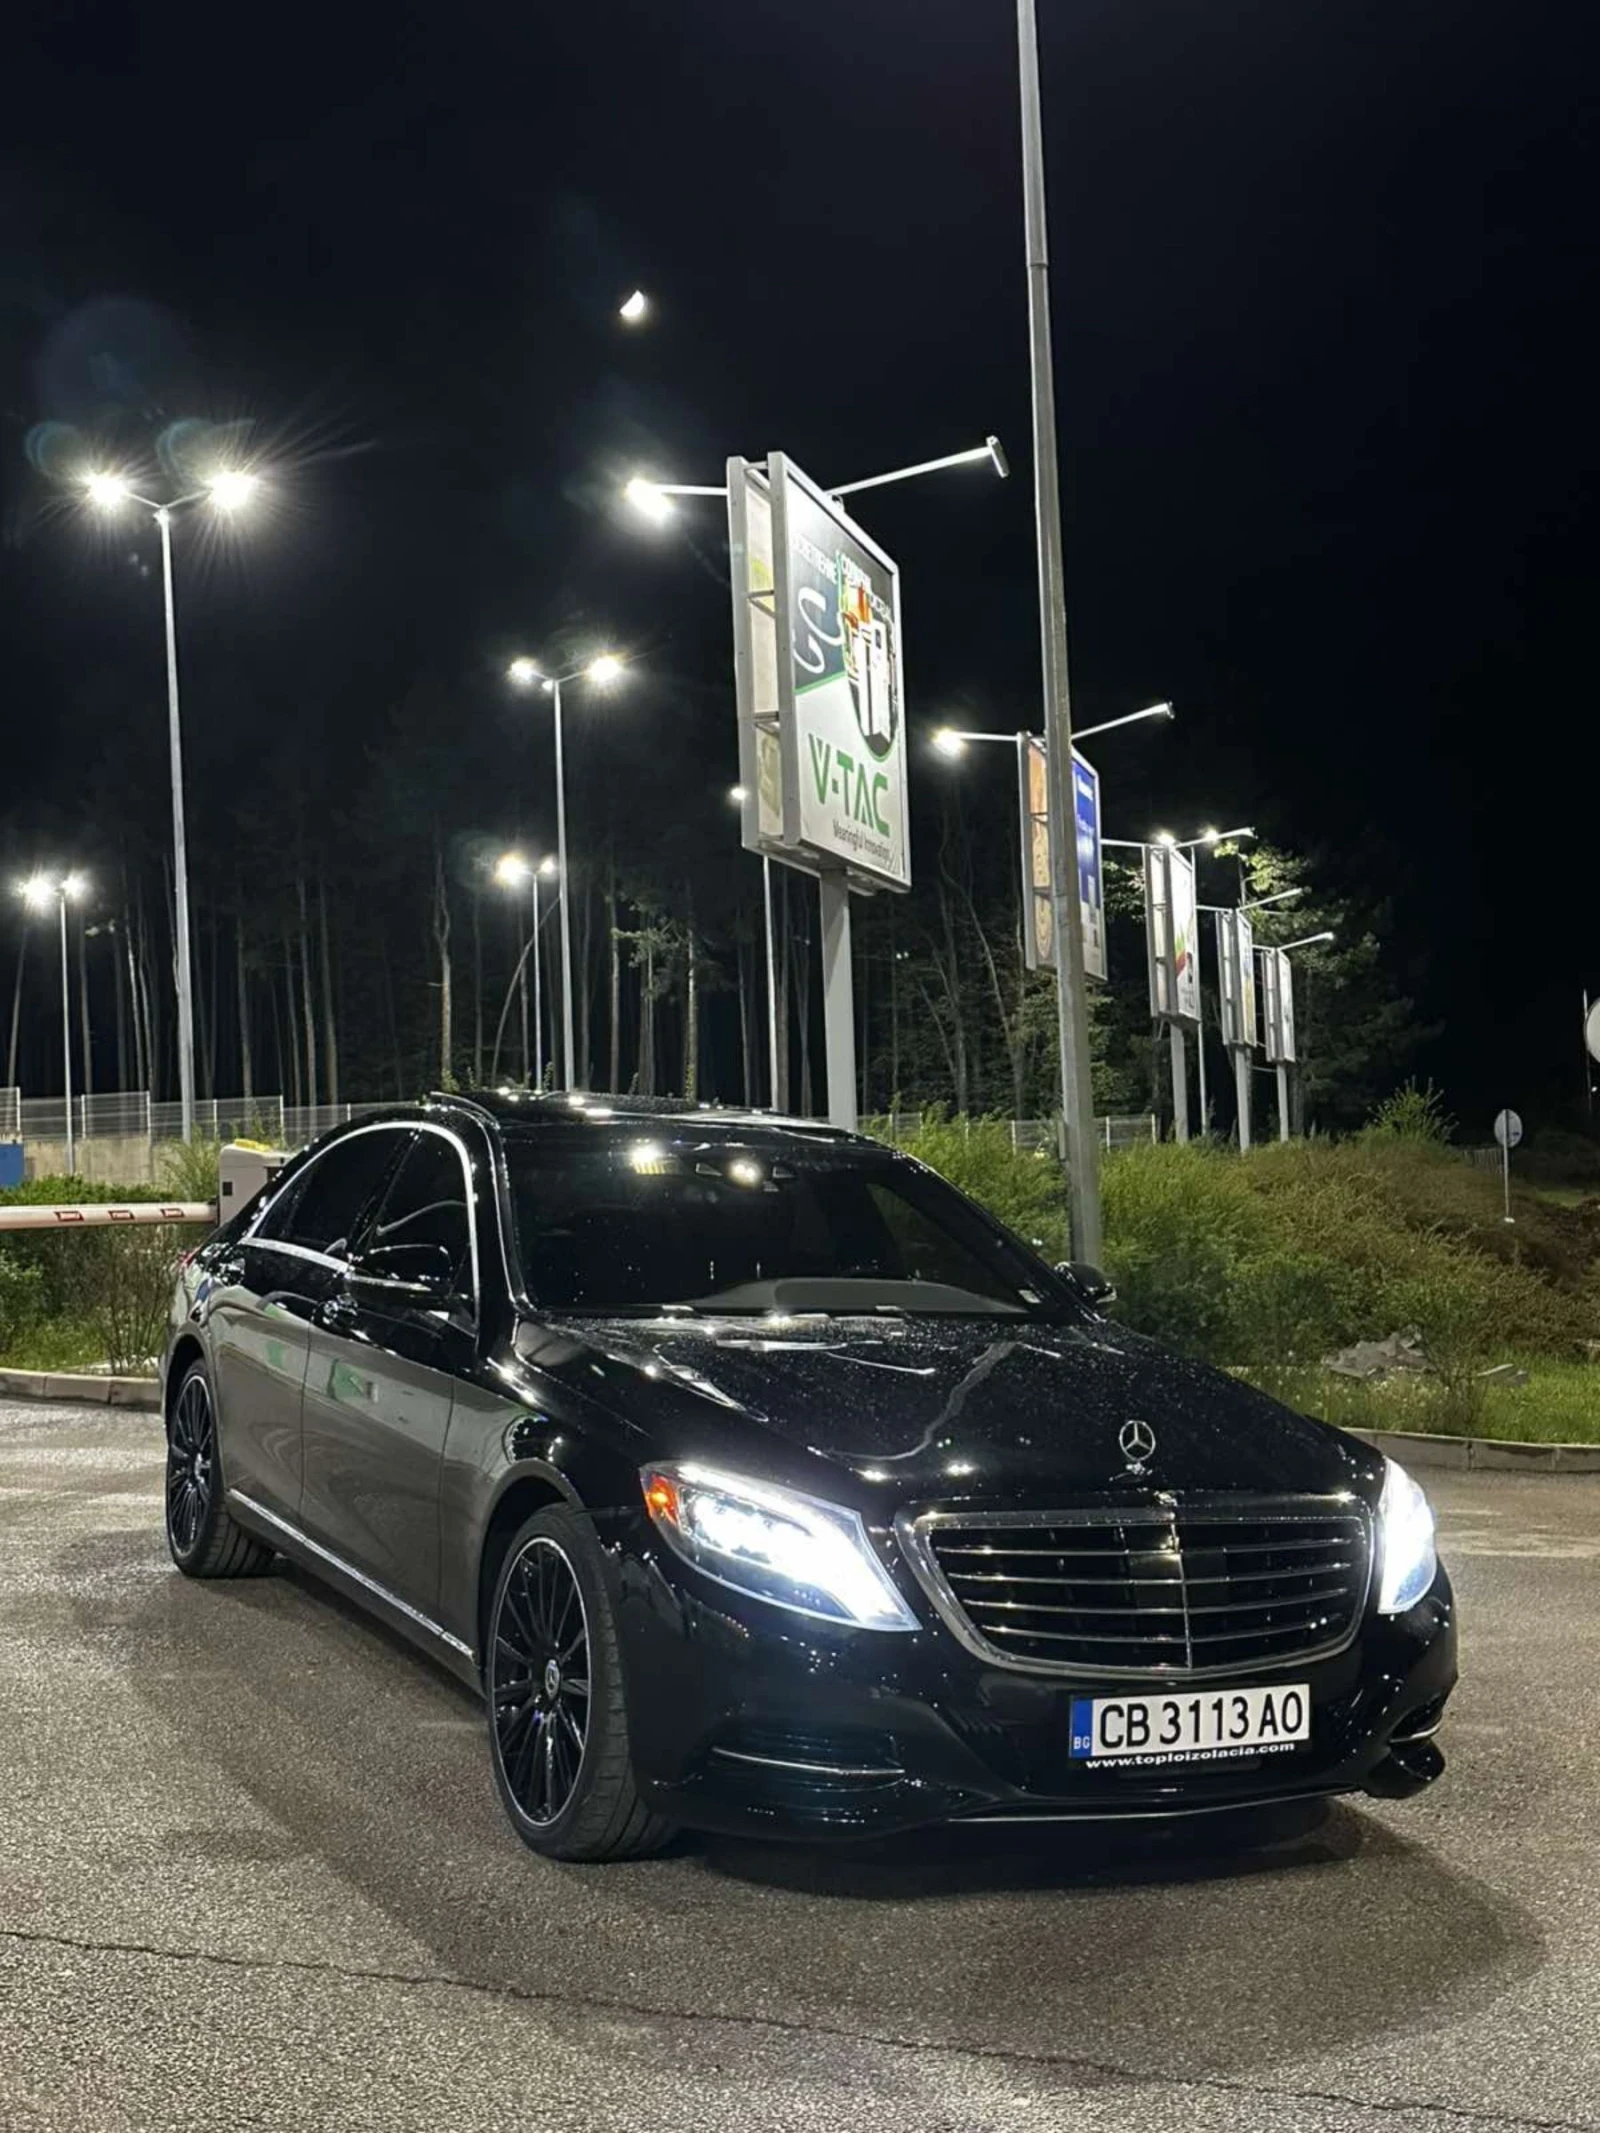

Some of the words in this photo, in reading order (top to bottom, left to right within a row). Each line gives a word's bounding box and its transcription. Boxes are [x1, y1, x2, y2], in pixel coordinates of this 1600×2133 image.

[1100, 1703, 1150, 1749] CB
[1159, 1696, 1249, 1744] 3113
[1258, 1691, 1301, 1738] AO
[1073, 1736, 1090, 1749] BG
[1085, 1742, 1295, 1768] www.toploizolacia.com
